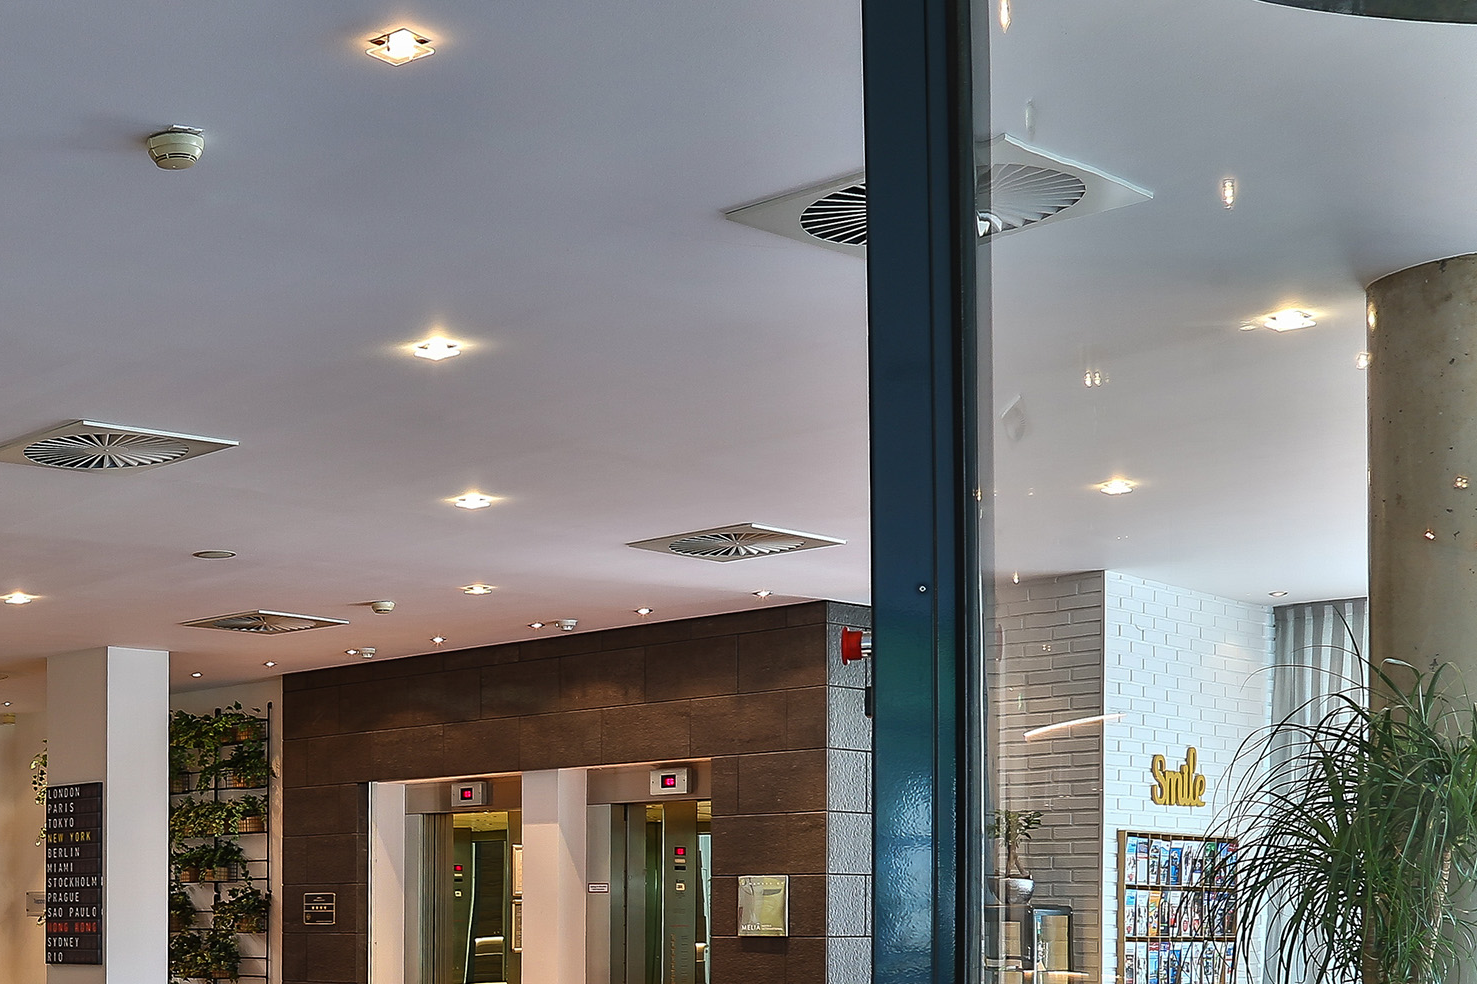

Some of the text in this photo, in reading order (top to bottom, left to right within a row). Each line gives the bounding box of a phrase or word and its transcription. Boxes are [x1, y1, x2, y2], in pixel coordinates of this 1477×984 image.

[1152, 747, 1206, 807] Smile
[48, 787, 80, 799] LONDON
[48, 802, 74, 814] PARIS
[48, 817, 74, 829] TOKYO
[48, 831, 92, 844] NEW YORK
[48, 847, 80, 859] BERLIN
[47, 862, 73, 873] MIAMI
[48, 876, 97, 888] STOCKHOLM
[48, 891, 80, 903] PRAGUE
[69, 906, 97, 918] PAULO
[47, 922, 97, 933] HONG KONG
[48, 937, 80, 948] SYDNEY
[47, 951, 63, 963] RIO
